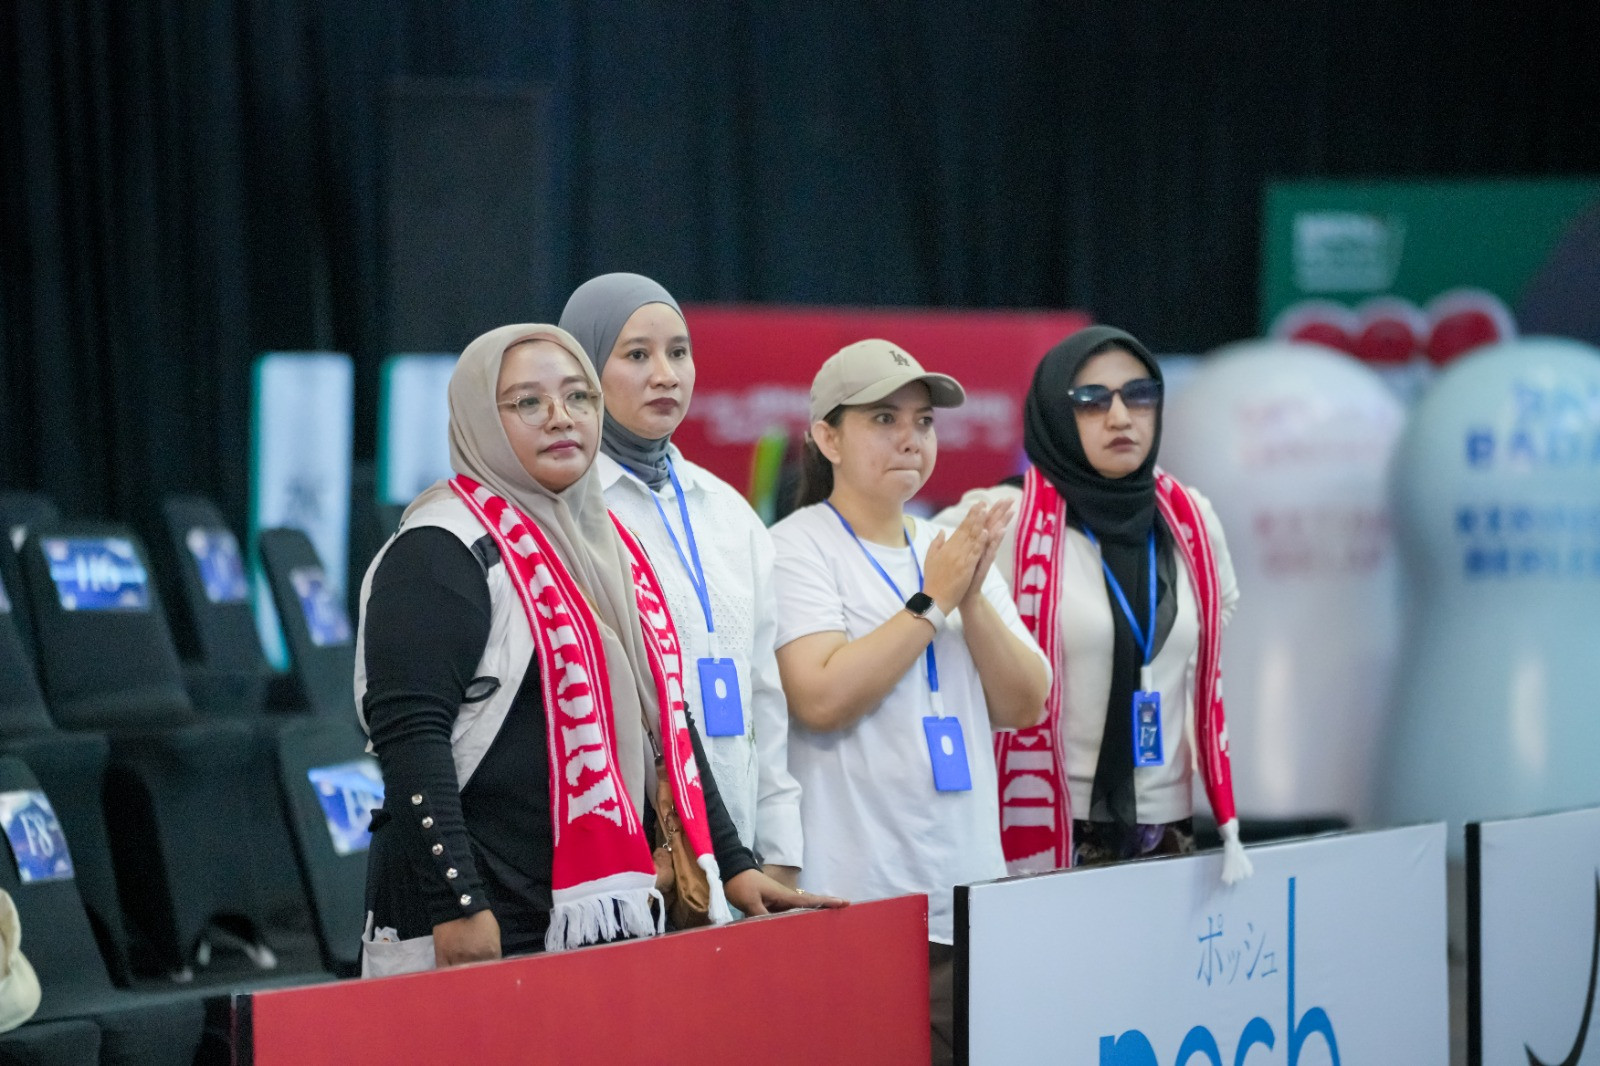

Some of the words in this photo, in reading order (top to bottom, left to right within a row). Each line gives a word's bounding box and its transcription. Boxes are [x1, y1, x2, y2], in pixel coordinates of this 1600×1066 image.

[530, 563, 622, 827] GLORY
[1197, 913, 1278, 987] ポッシュ
